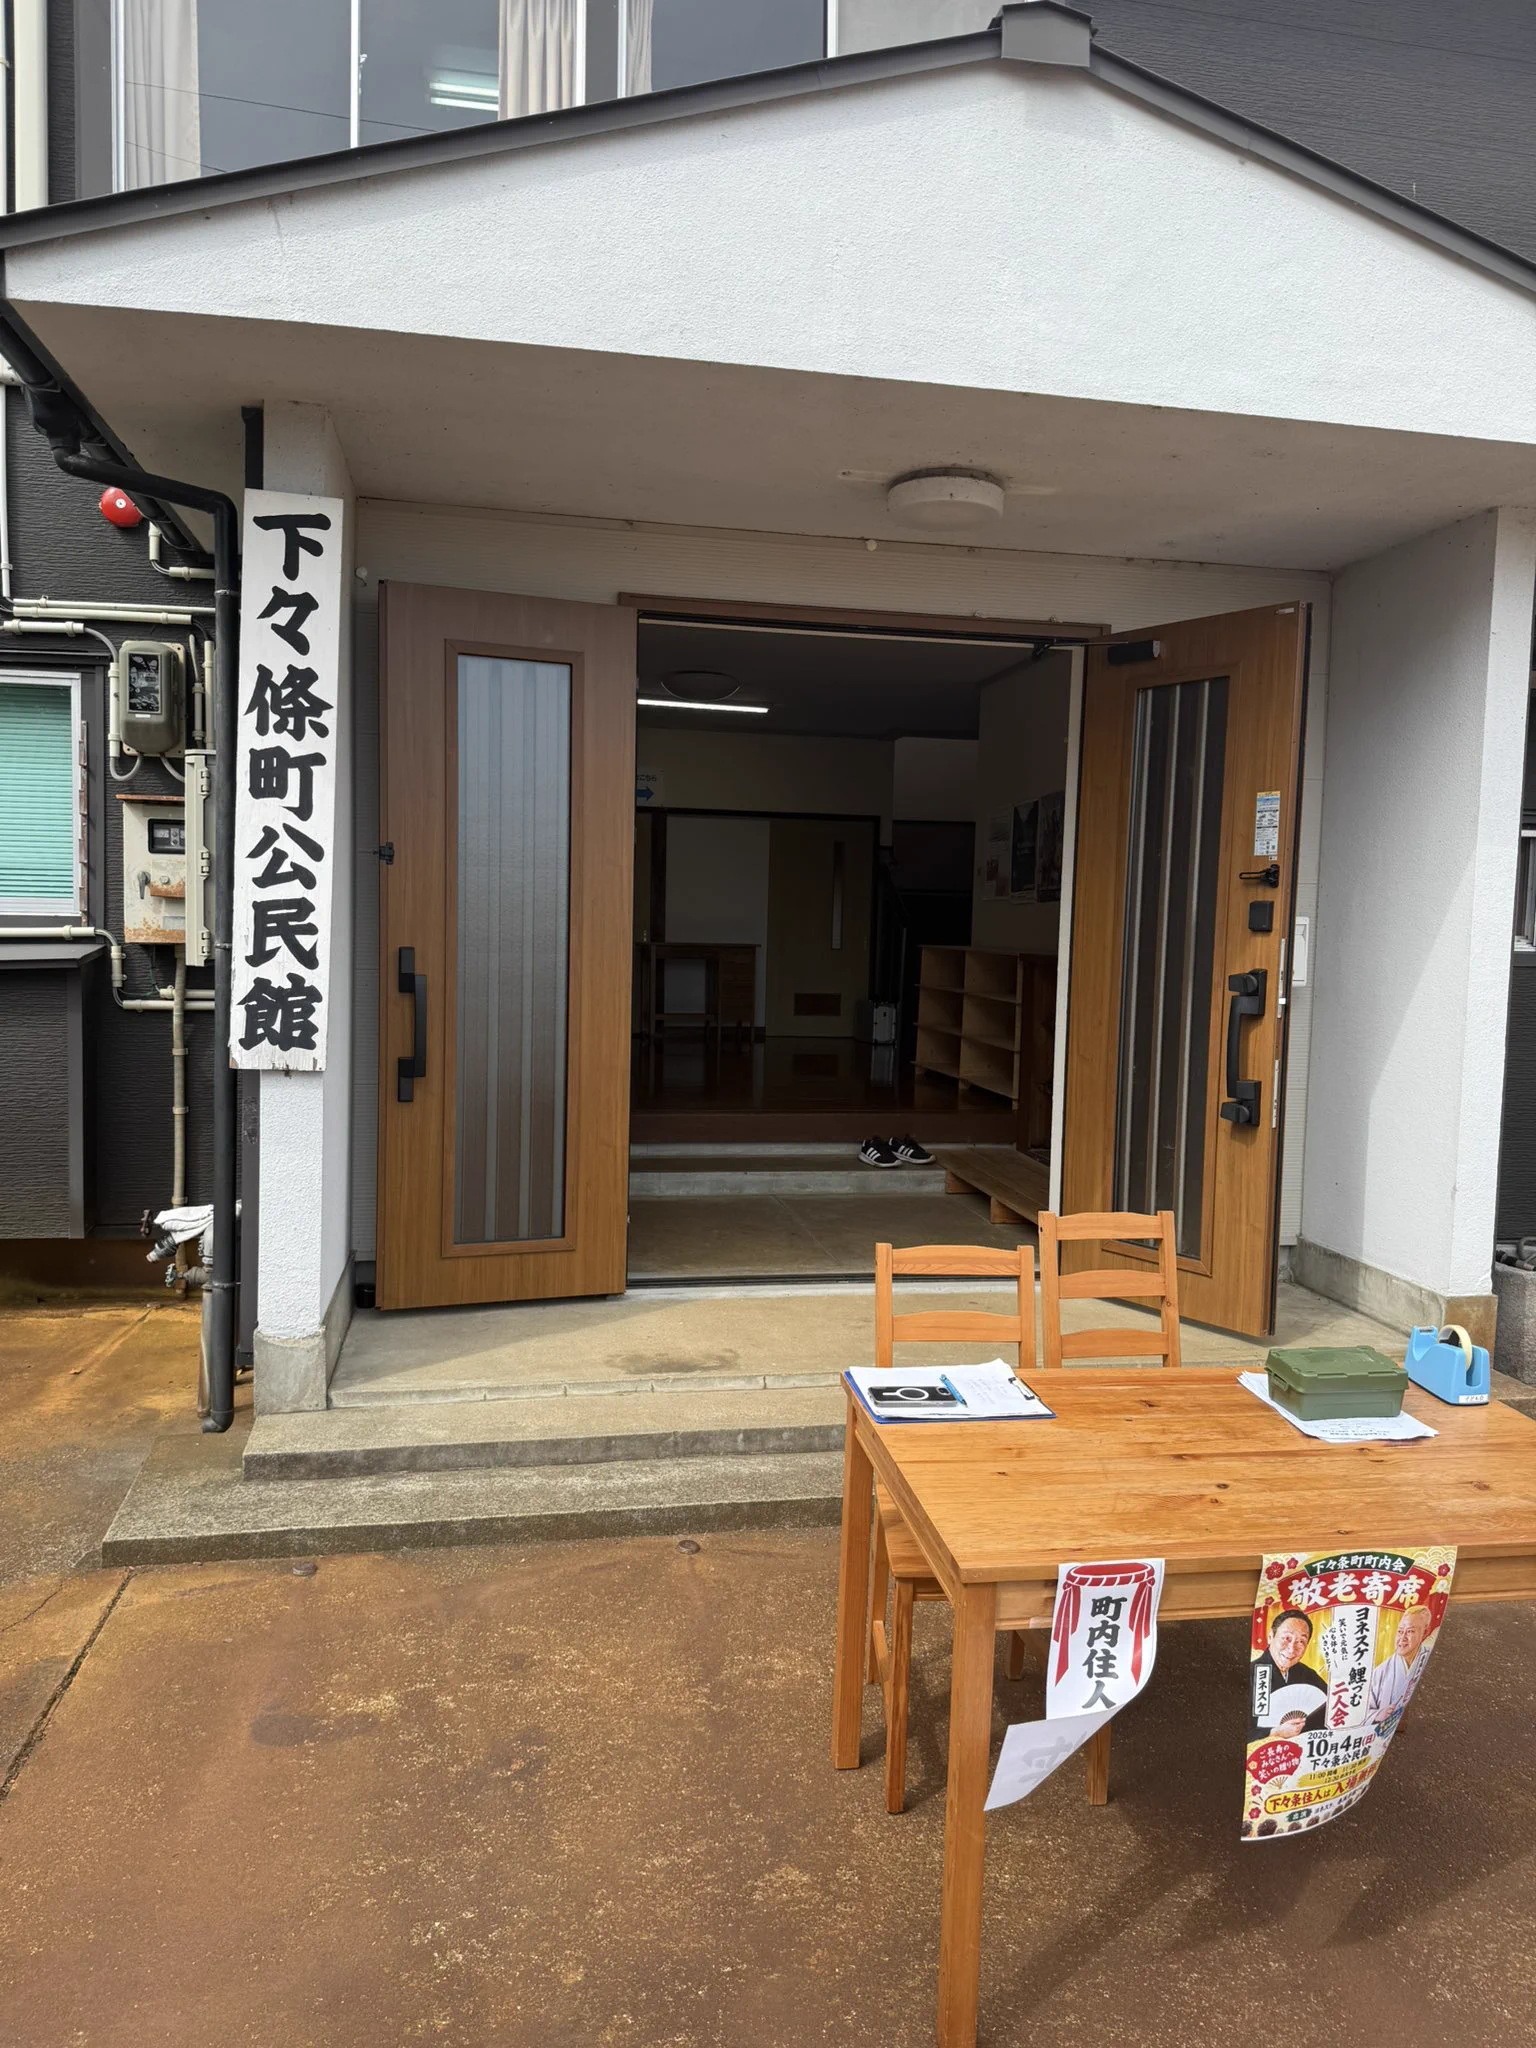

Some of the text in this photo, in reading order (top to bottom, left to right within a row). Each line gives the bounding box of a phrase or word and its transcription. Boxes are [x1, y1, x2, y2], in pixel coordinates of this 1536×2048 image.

[237, 513, 334, 1053] 下々條町公民館
[1312, 1554, 1407, 1574] 下々条町町内会
[1288, 1571, 1425, 1610] 敬老寄席
[1082, 1596, 1127, 1709] 町内住人
[1257, 1669, 1268, 1713] ヨネスケ
[1330, 1681, 1349, 1728] 二人会
[1307, 1731, 1334, 1740] 2026年
[1310, 1745, 1371, 1771] 下々条公民館
